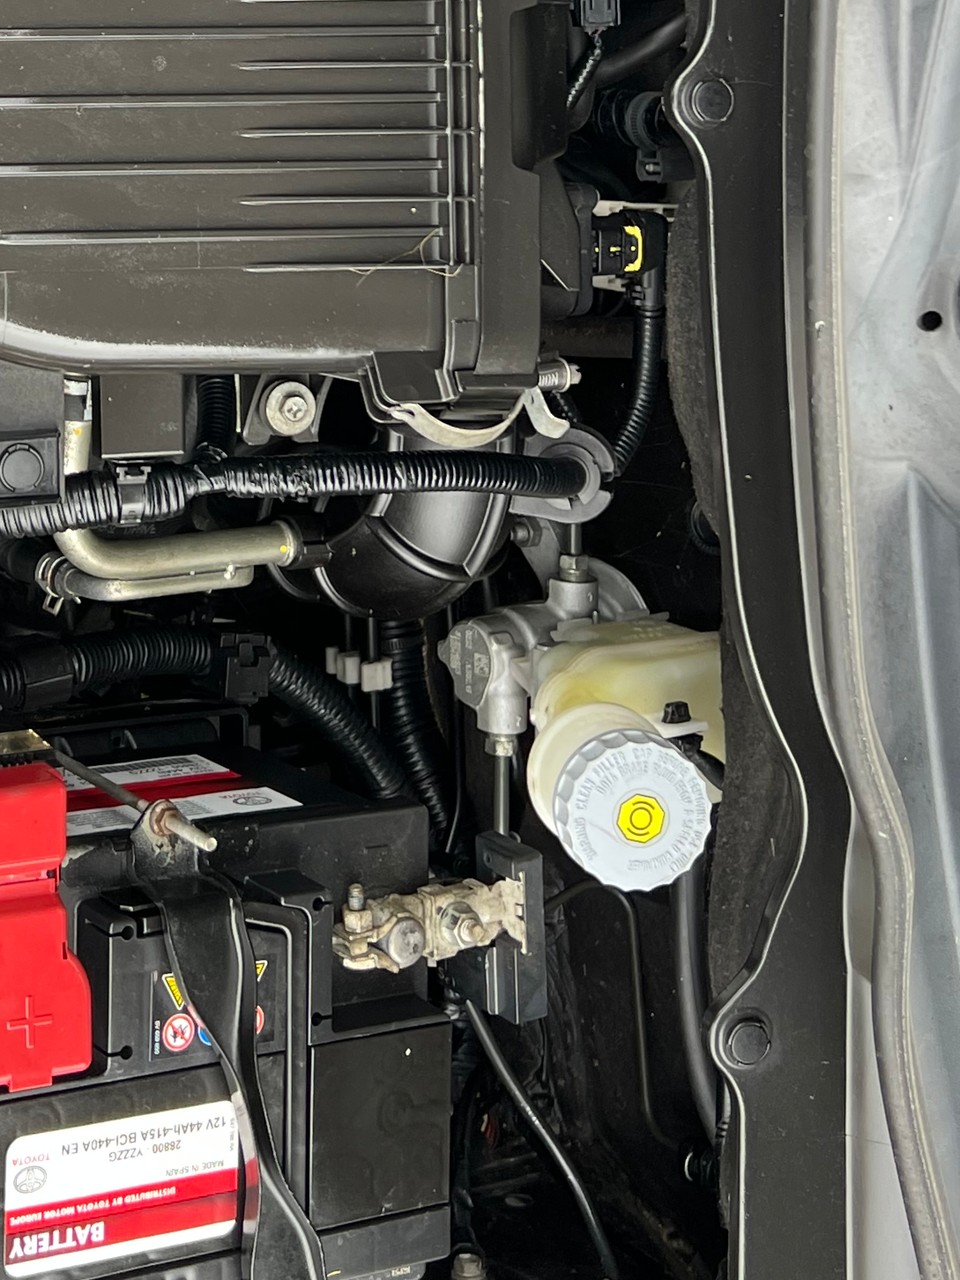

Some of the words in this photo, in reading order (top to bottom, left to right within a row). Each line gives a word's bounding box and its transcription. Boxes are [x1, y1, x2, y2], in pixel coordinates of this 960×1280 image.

[619, 760, 649, 778] BRAKE
[575, 777, 596, 810] CLEAN
[592, 750, 626, 774] FILLER
[632, 747, 653, 760] CAP
[140, 1120, 202, 1138] 44Ah-415A
[207, 1116, 227, 1129] 12V
[82, 1131, 137, 1151] BCI-440A
[152, 1140, 182, 1154] 28800
[61, 1144, 79, 1156] EN
[109, 1148, 143, 1163] YZZZG
[12, 1153, 50, 1166] TOYOTA
[201, 1160, 224, 1169] MADE
[165, 1166, 191, 1177] SPAIN
[192, 1164, 200, 1172] IN
[112, 1197, 124, 1206] BY
[125, 1186, 177, 1203] DISTRIBUTED
[44, 1205, 76, 1220] MOTOR
[77, 1199, 111, 1213] TOYOTA
[9, 1211, 43, 1227] EUROPE
[9, 1221, 105, 1259] BATTERY
